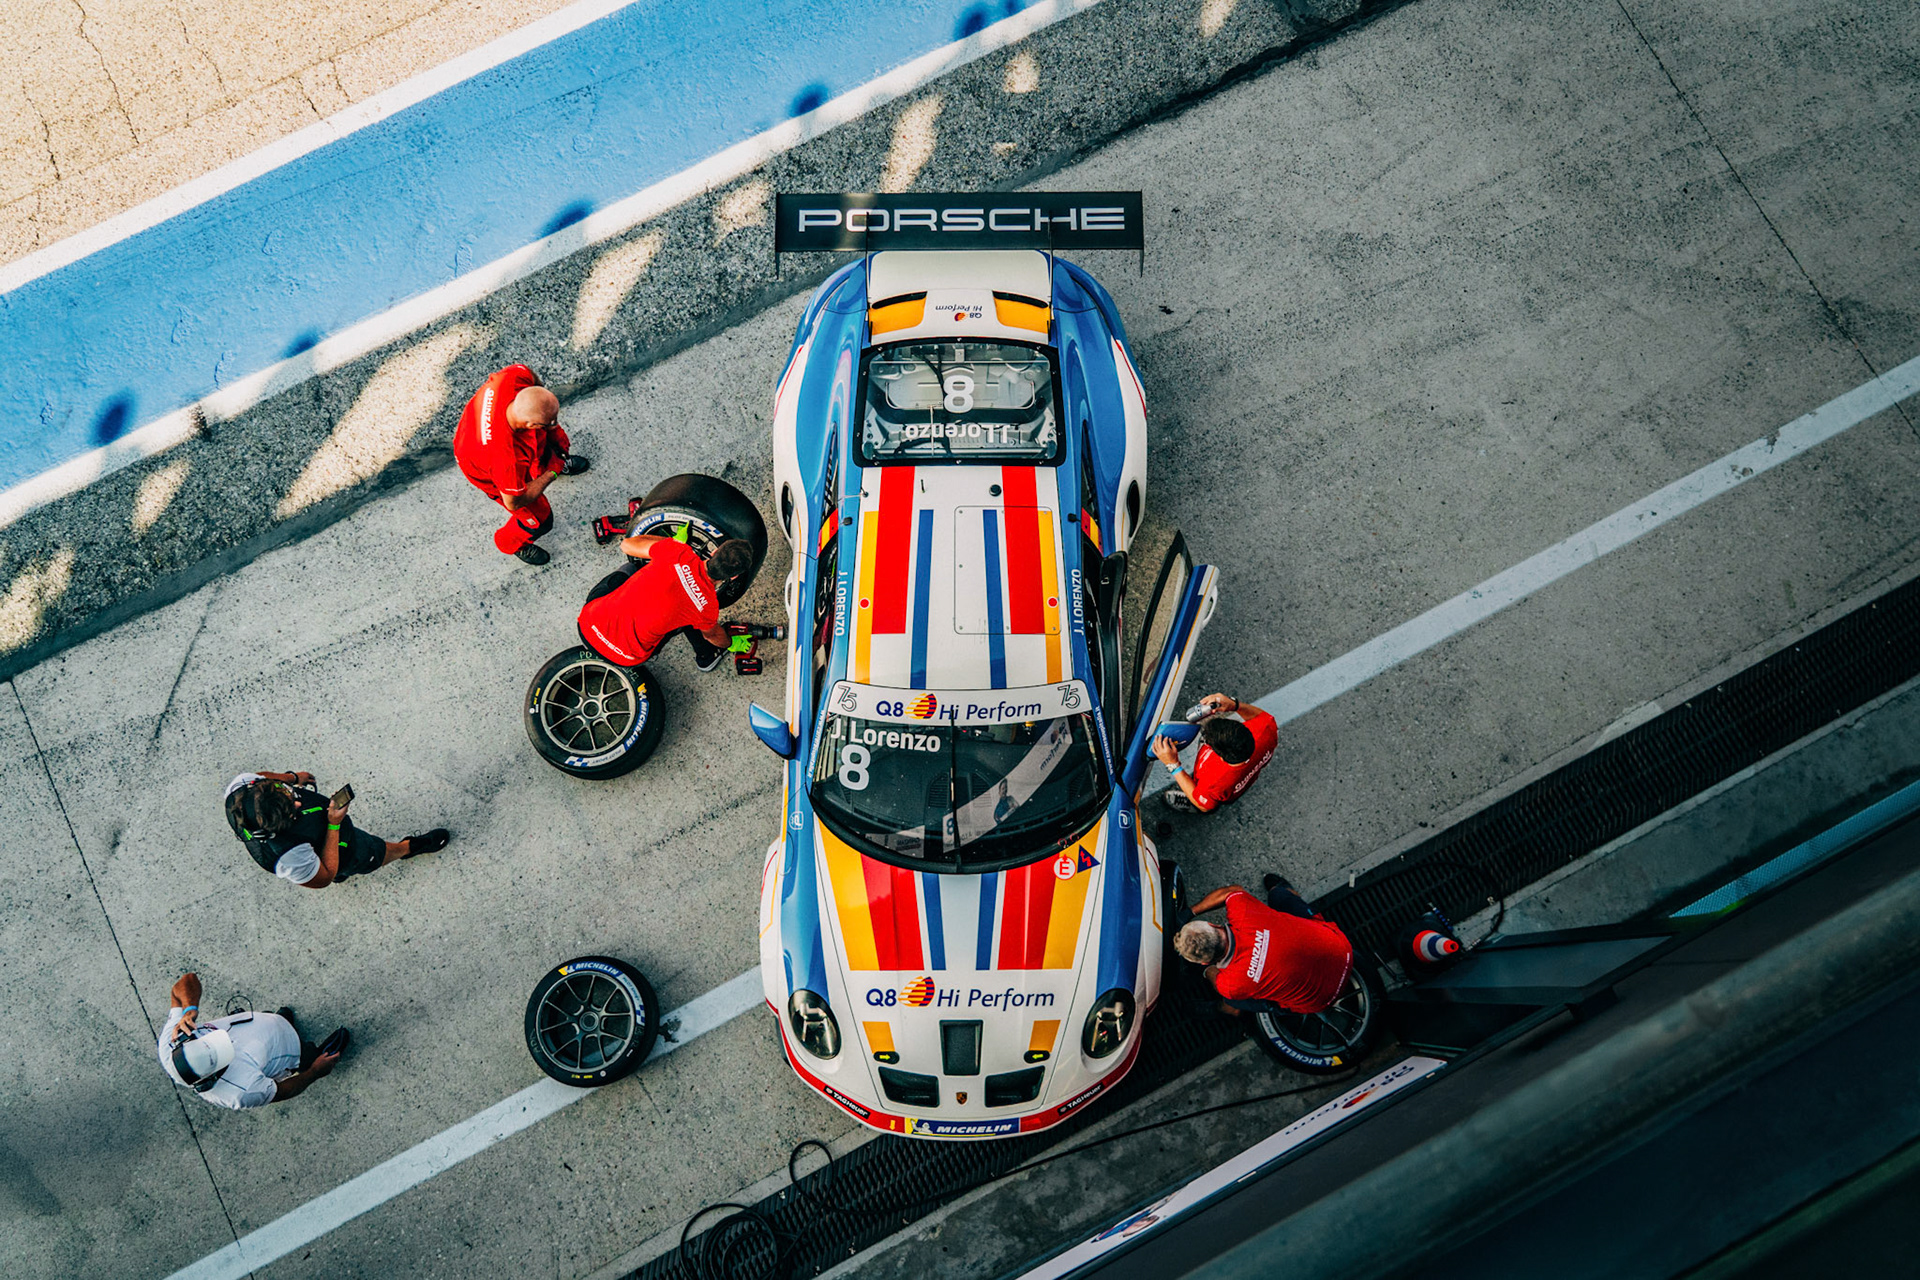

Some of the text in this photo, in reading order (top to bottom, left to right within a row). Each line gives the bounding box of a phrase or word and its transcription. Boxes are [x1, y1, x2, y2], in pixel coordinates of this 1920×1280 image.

[799, 208, 1125, 232] PORSCHE
[943, 374, 975, 413] 8
[485, 389, 495, 441] GHINZANI
[682, 564, 708, 606] GHINZANI
[1071, 569, 1083, 624] LORENZO
[835, 581, 847, 636] LORENZO
[837, 685, 857, 712] 75
[876, 700, 1042, 720] Q8 Hi Perform
[1058, 684, 1081, 709] 75
[626, 702, 648, 747] MICHELIN
[850, 720, 941, 753] Lorenzo
[838, 744, 871, 791] 8
[575, 962, 619, 975] MICHELIN
[1247, 930, 1264, 978] GHINZANI
[866, 988, 1055, 1011] Q8 Hi Perform
[1275, 1040, 1323, 1065] MICHELIN
[936, 1123, 1012, 1134] MICHELIN
